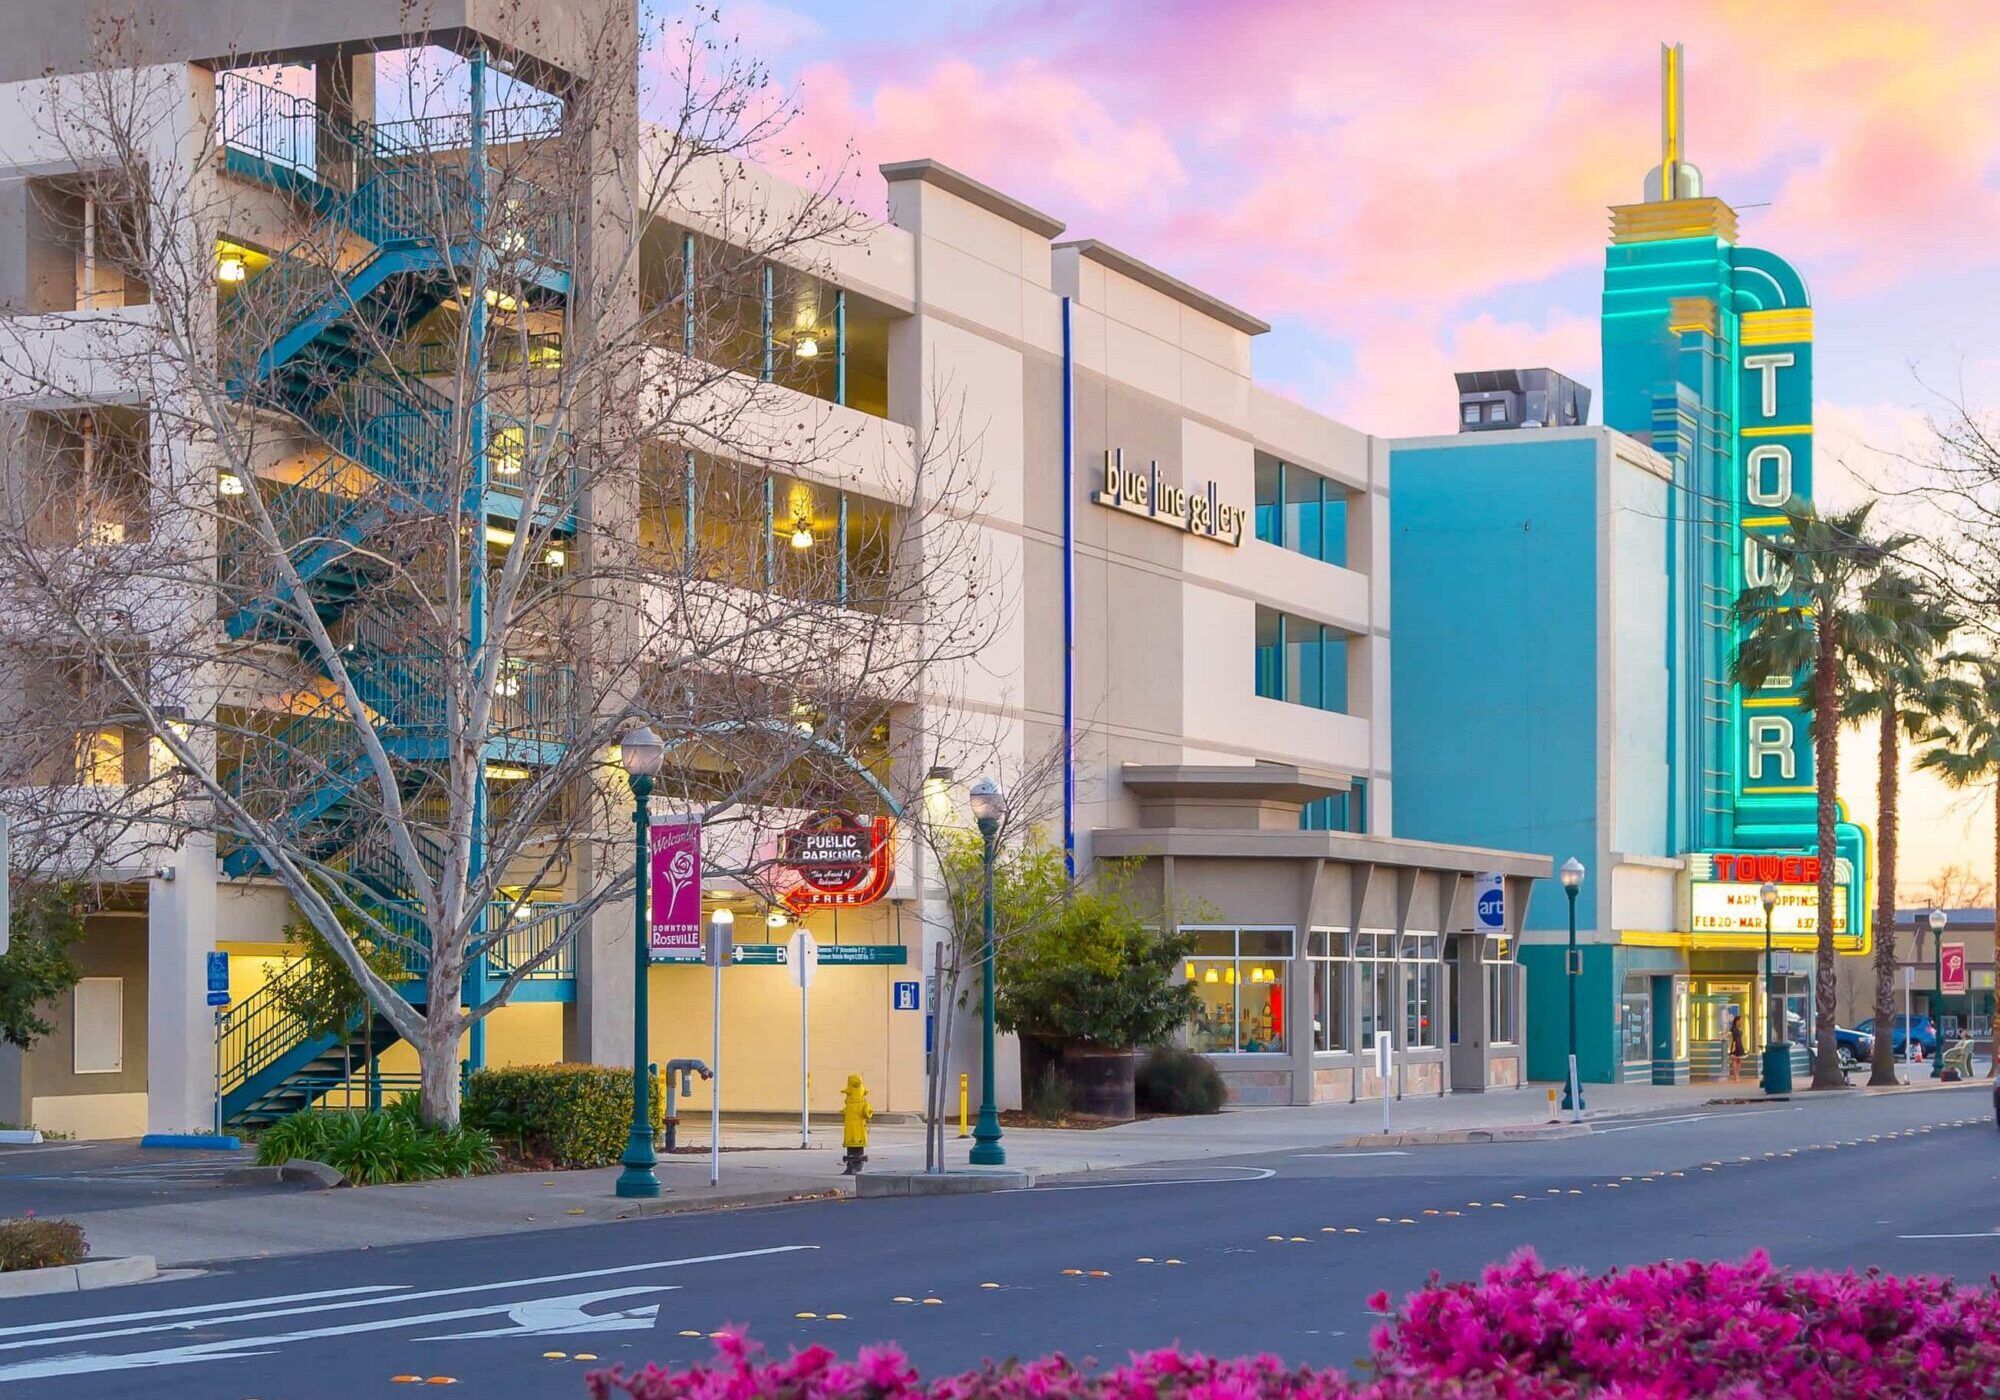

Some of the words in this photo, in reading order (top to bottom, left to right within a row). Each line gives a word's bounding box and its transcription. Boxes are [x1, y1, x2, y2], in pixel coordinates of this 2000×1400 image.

[1104, 448, 1148, 506] blue
[1150, 460, 1187, 517] line
[1189, 480, 1246, 547] gallery
[1744, 352, 1796, 780] TOWR
[807, 835, 857, 849] PUBLIC
[802, 849, 862, 860] PARKING
[1713, 854, 1820, 884] TOWER
[812, 894, 856, 903] FREE
[1727, 895, 1758, 905] MARY
[1773, 895, 1820, 906] OPPINS
[1479, 899, 1504, 915] art
[652, 924, 699, 932] DOWNTOWN
